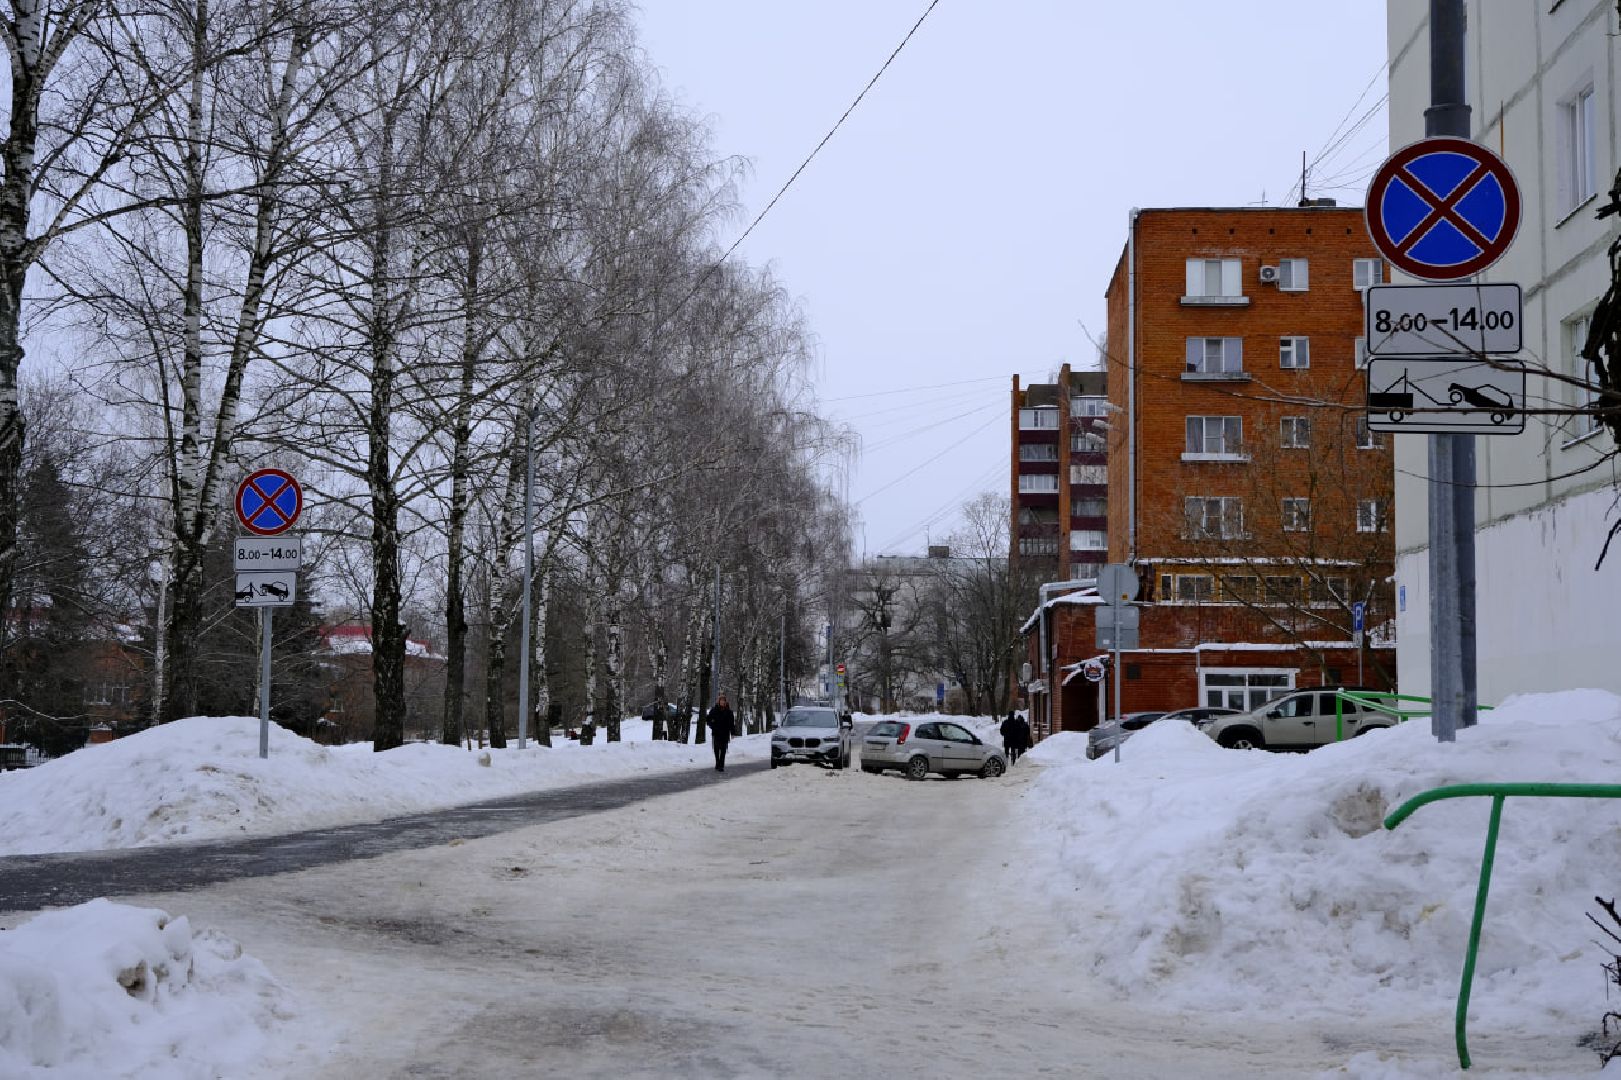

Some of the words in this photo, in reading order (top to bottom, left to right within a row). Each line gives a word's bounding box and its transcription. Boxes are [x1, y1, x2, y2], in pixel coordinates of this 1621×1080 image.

[1375, 306, 1514, 332] 8.00-14.00
[238, 548, 298, 560] 8.00-14.00
[1355, 605, 1362, 630] P
